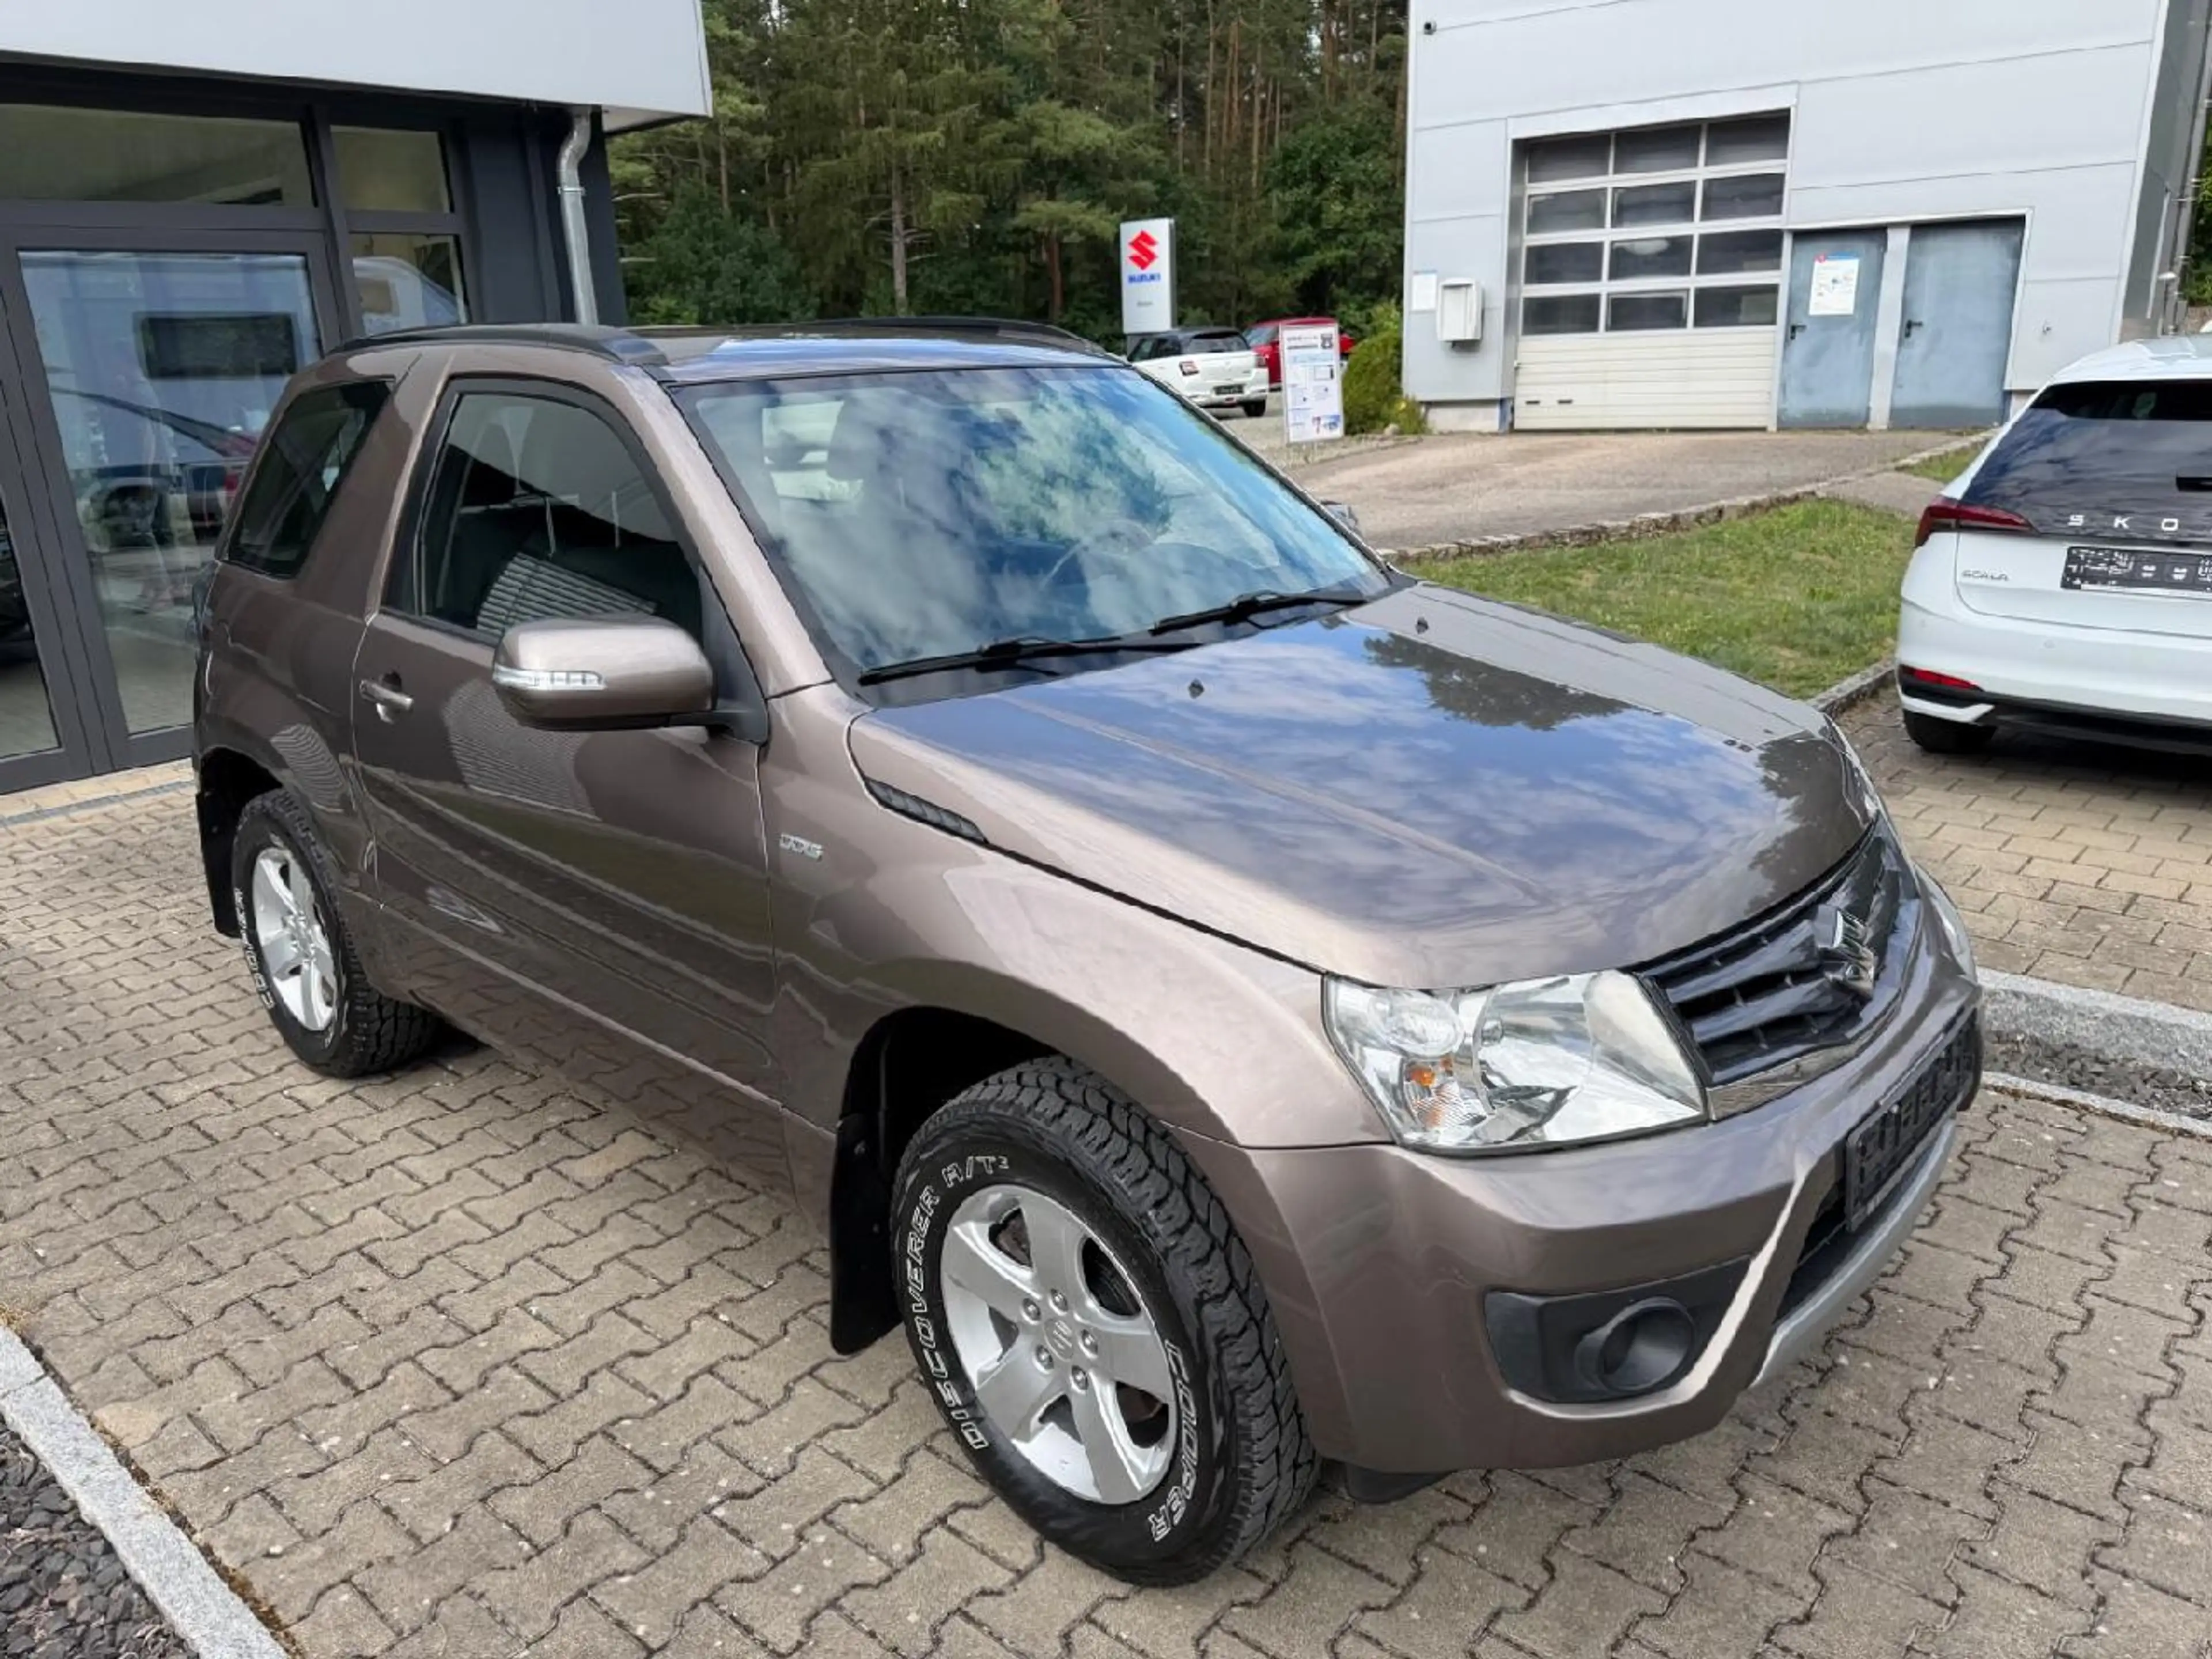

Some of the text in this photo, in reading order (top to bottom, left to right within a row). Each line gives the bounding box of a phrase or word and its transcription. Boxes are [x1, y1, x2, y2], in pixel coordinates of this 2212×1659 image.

[2067, 514, 2212, 533] SKO
[907, 1185, 989, 1449] DISCOVERER
[1147, 1339, 1198, 1542] COOPER
